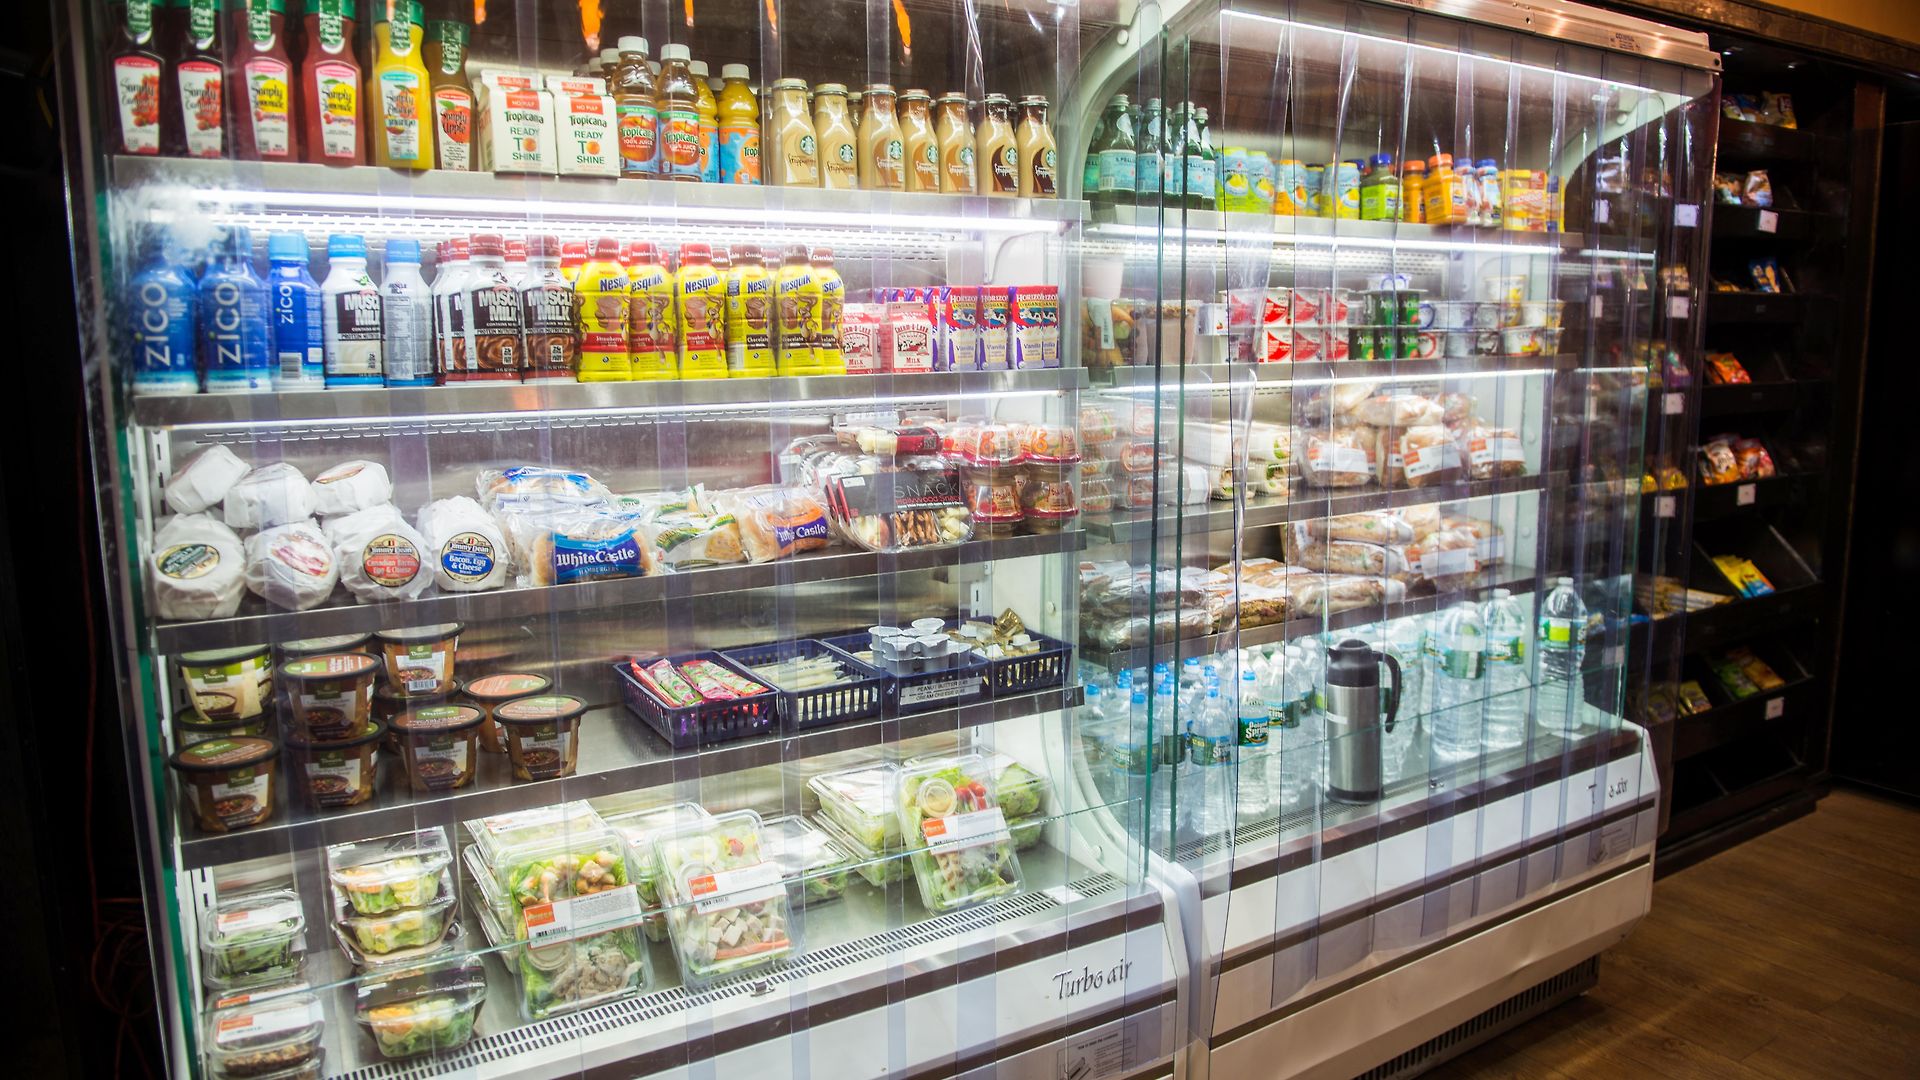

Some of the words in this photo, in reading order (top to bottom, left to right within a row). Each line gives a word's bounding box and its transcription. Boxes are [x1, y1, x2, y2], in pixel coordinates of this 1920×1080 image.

[120, 78, 155, 97] Simply
[183, 82, 218, 101] Simply
[251, 80, 284, 100] Simply
[321, 84, 353, 104] Simply
[386, 90, 414, 105] Simply
[440, 108, 468, 124] Simply
[504, 111, 544, 124] Tropicana
[568, 115, 608, 128] Tropicana
[510, 127, 540, 137] READY
[574, 131, 604, 139] READY
[621, 127, 654, 140] Tropicana
[665, 131, 699, 145] Tropicana
[638, 139, 653, 147] JUICE
[512, 152, 542, 162] SHINE
[576, 155, 605, 165] SHINE
[631, 274, 663, 293] esquik
[685, 274, 720, 294] Nesquik
[780, 274, 811, 294] Nesquik
[536, 304, 571, 321] MILK
[986, 343, 1006, 351] Vanilla
[895, 482, 960, 498] SNACK
[796, 523, 827, 538] Castle
[450, 543, 472, 552] Jimmy
[472, 545, 490, 554] Dean
[366, 559, 396, 567] Canadian
[473, 559, 486, 567] Egg
[556, 551, 597, 567] White
[596, 548, 636, 564] Castle
[373, 566, 384, 574] Egg
[392, 566, 412, 574] Cheese
[458, 563, 483, 572] Cheese
[917, 684, 937, 692] PEANUT
[916, 693, 934, 701] CREAM
[1052, 964, 1103, 1000] Turbo
[1107, 958, 1133, 985] air
